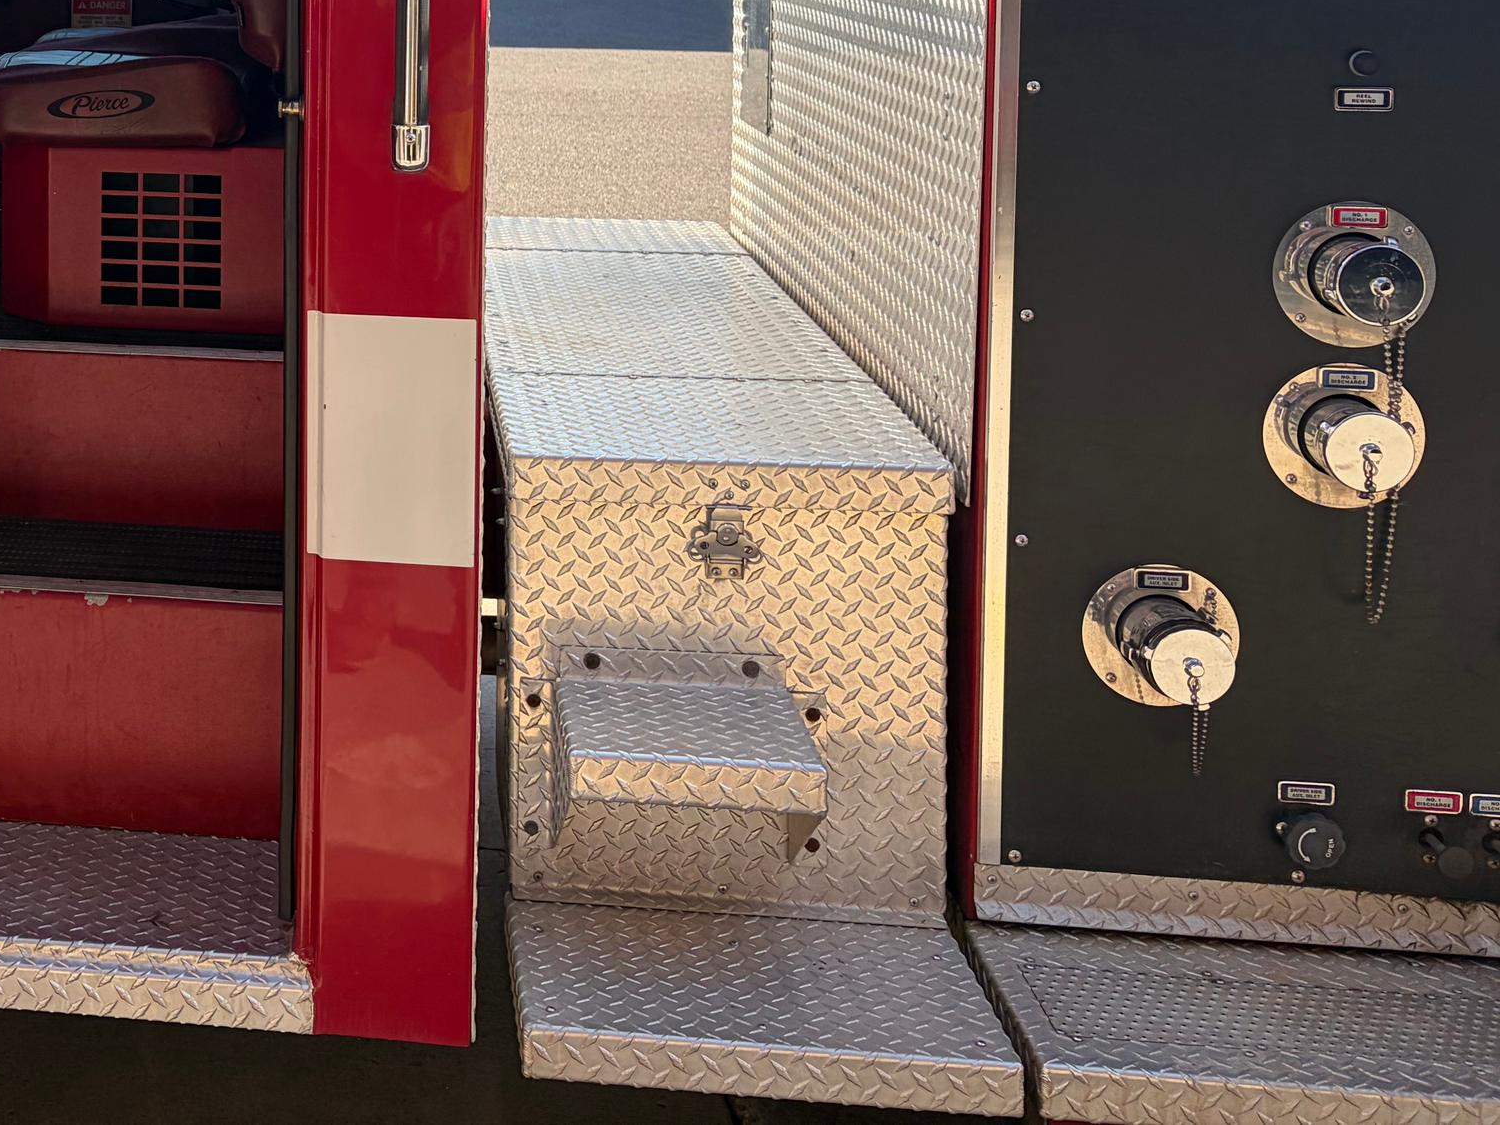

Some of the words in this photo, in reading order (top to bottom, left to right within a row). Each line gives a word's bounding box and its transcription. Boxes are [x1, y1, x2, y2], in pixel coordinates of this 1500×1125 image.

[90, 1, 126, 10] DANGER
[71, 94, 130, 116] Pierce
[1325, 838, 1335, 858] OPEN
